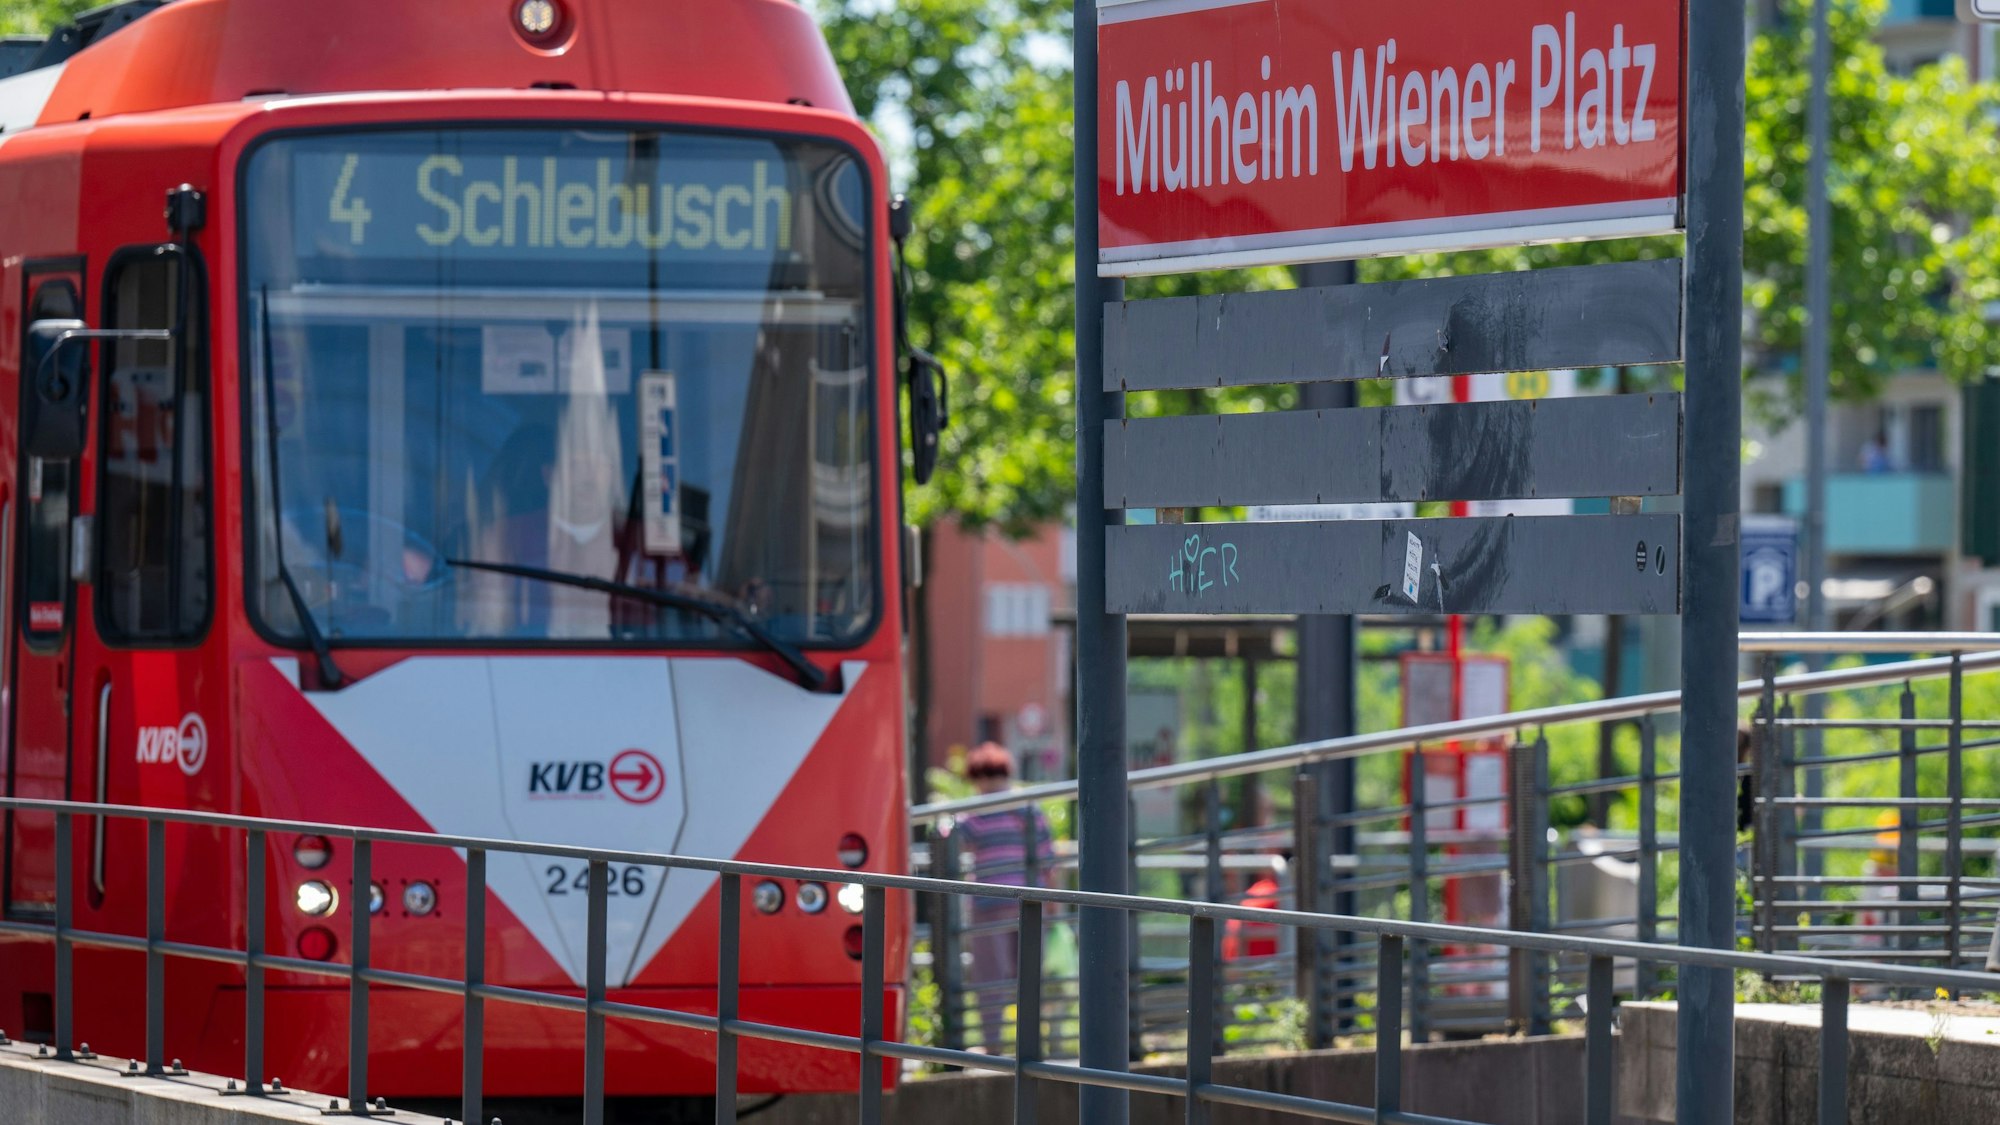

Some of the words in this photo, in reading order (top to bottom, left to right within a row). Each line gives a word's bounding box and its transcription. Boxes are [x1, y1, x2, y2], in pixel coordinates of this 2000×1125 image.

[1115, 55, 1318, 196] Mülheim
[1332, 38, 1515, 173] Wiener
[1530, 11, 1657, 152] Platz
[329, 153, 372, 245] 4
[416, 154, 791, 251] Schlebusch
[1752, 564, 1782, 611] P
[136, 726, 178, 763] KVB
[529, 762, 604, 793] KVB
[546, 865, 645, 896] 2426
